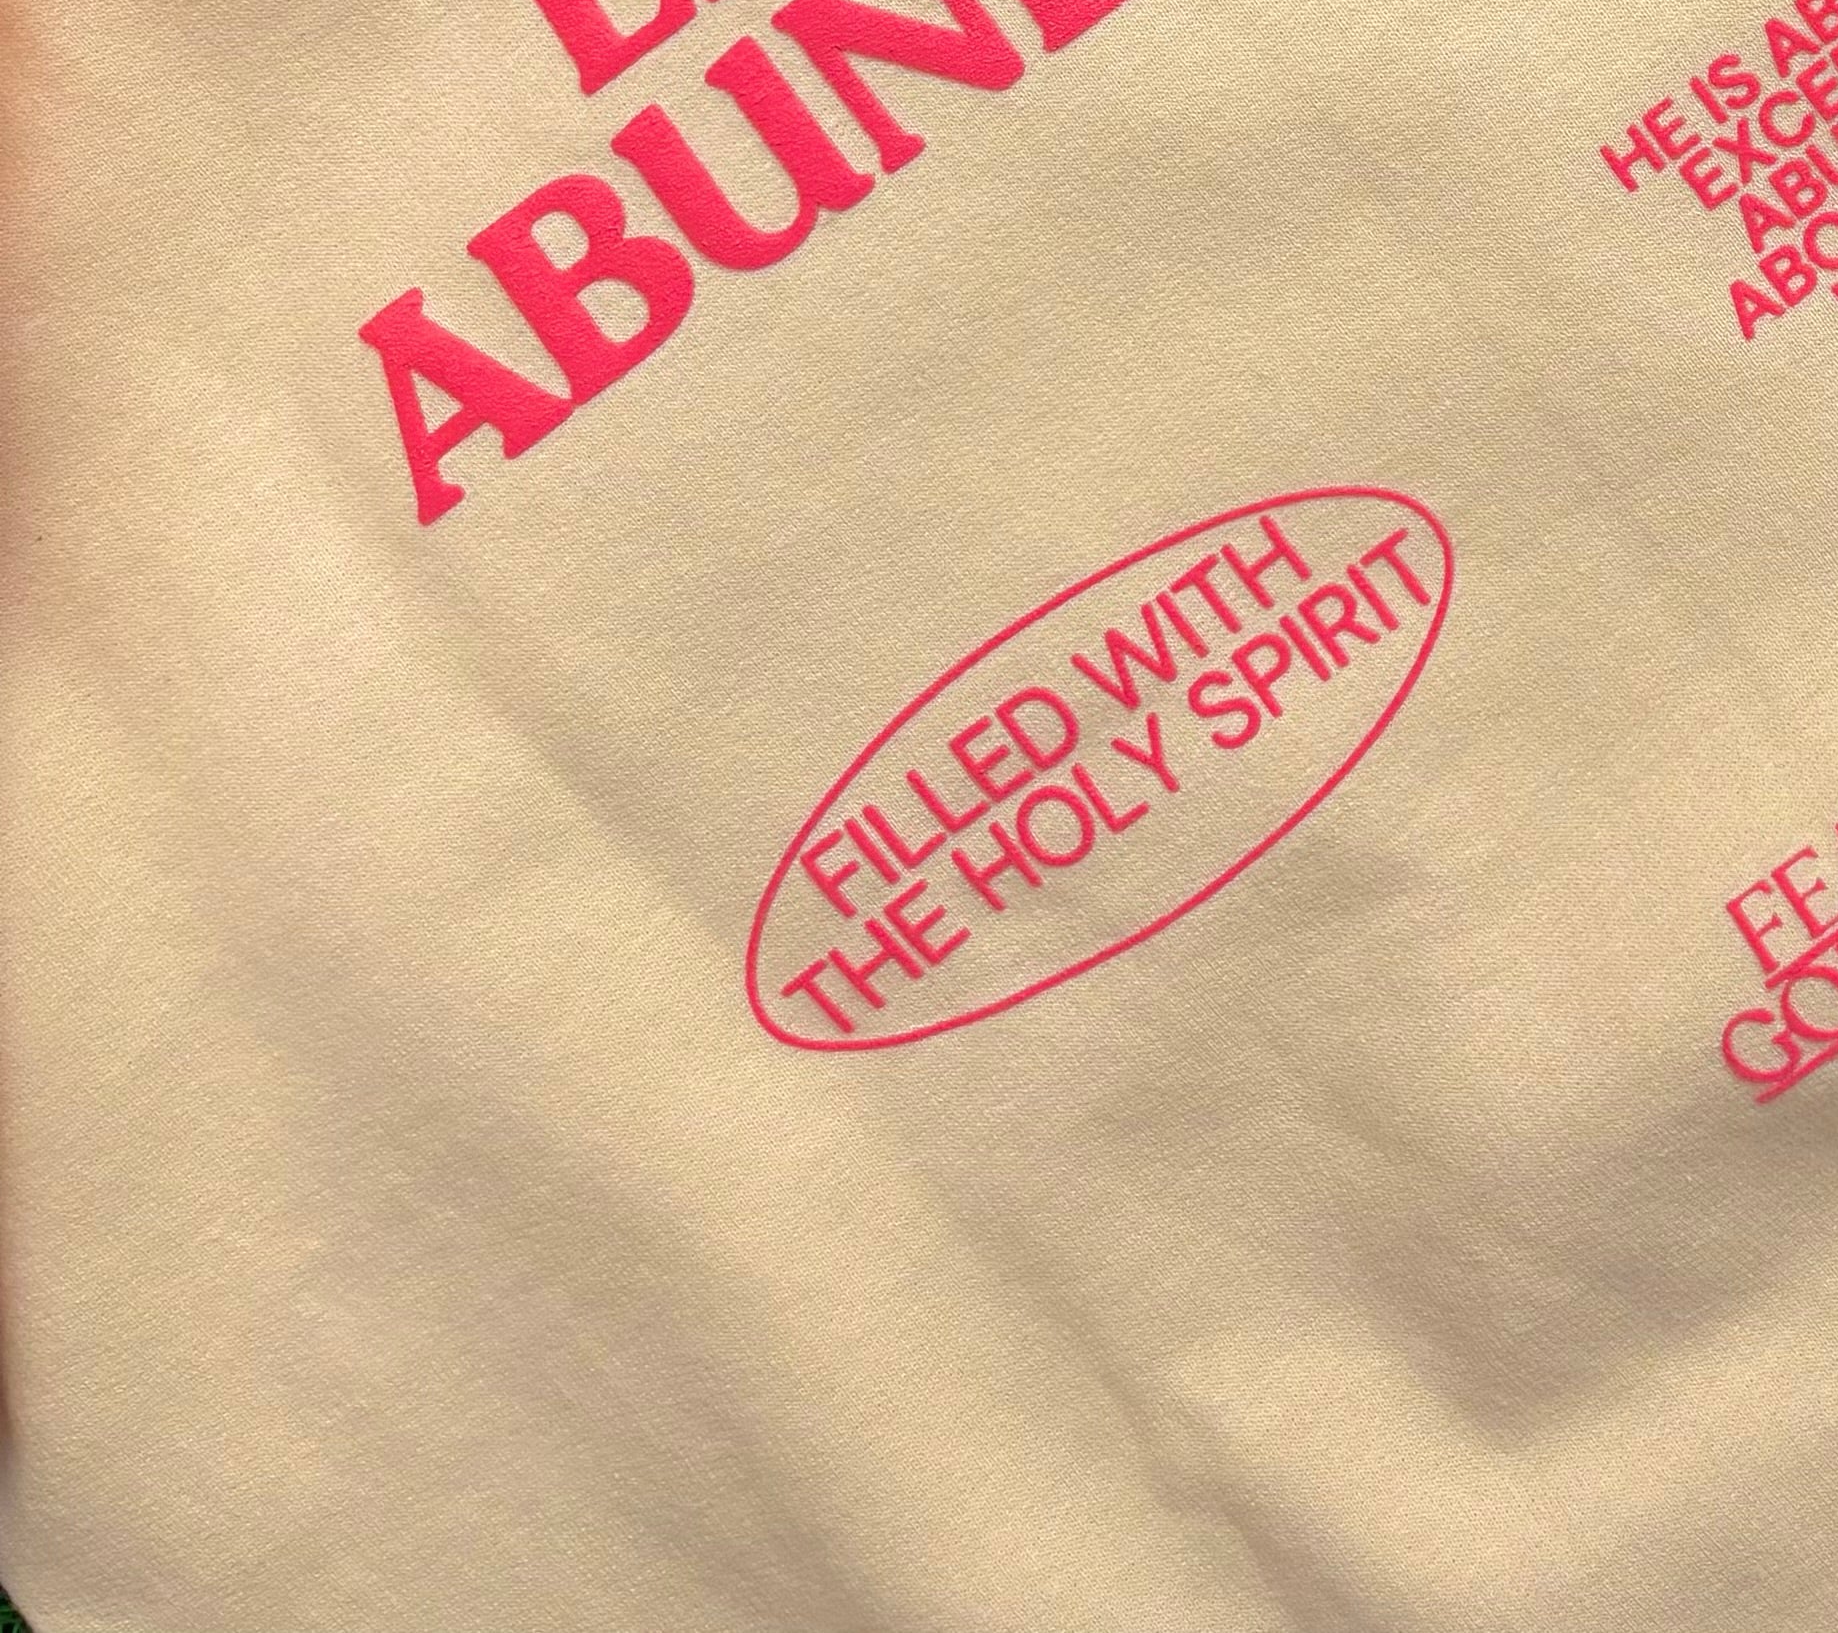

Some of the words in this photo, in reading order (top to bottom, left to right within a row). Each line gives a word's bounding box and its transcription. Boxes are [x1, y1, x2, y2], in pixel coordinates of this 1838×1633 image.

[1600, 98, 1702, 193] HE
[1689, 54, 1761, 124] IS
[781, 879, 971, 1034] THE
[951, 712, 1180, 911] HOLY
[1187, 528, 1431, 750] SPIRIT
[801, 686, 1080, 918] FILLED
[1071, 514, 1311, 710] WITH
